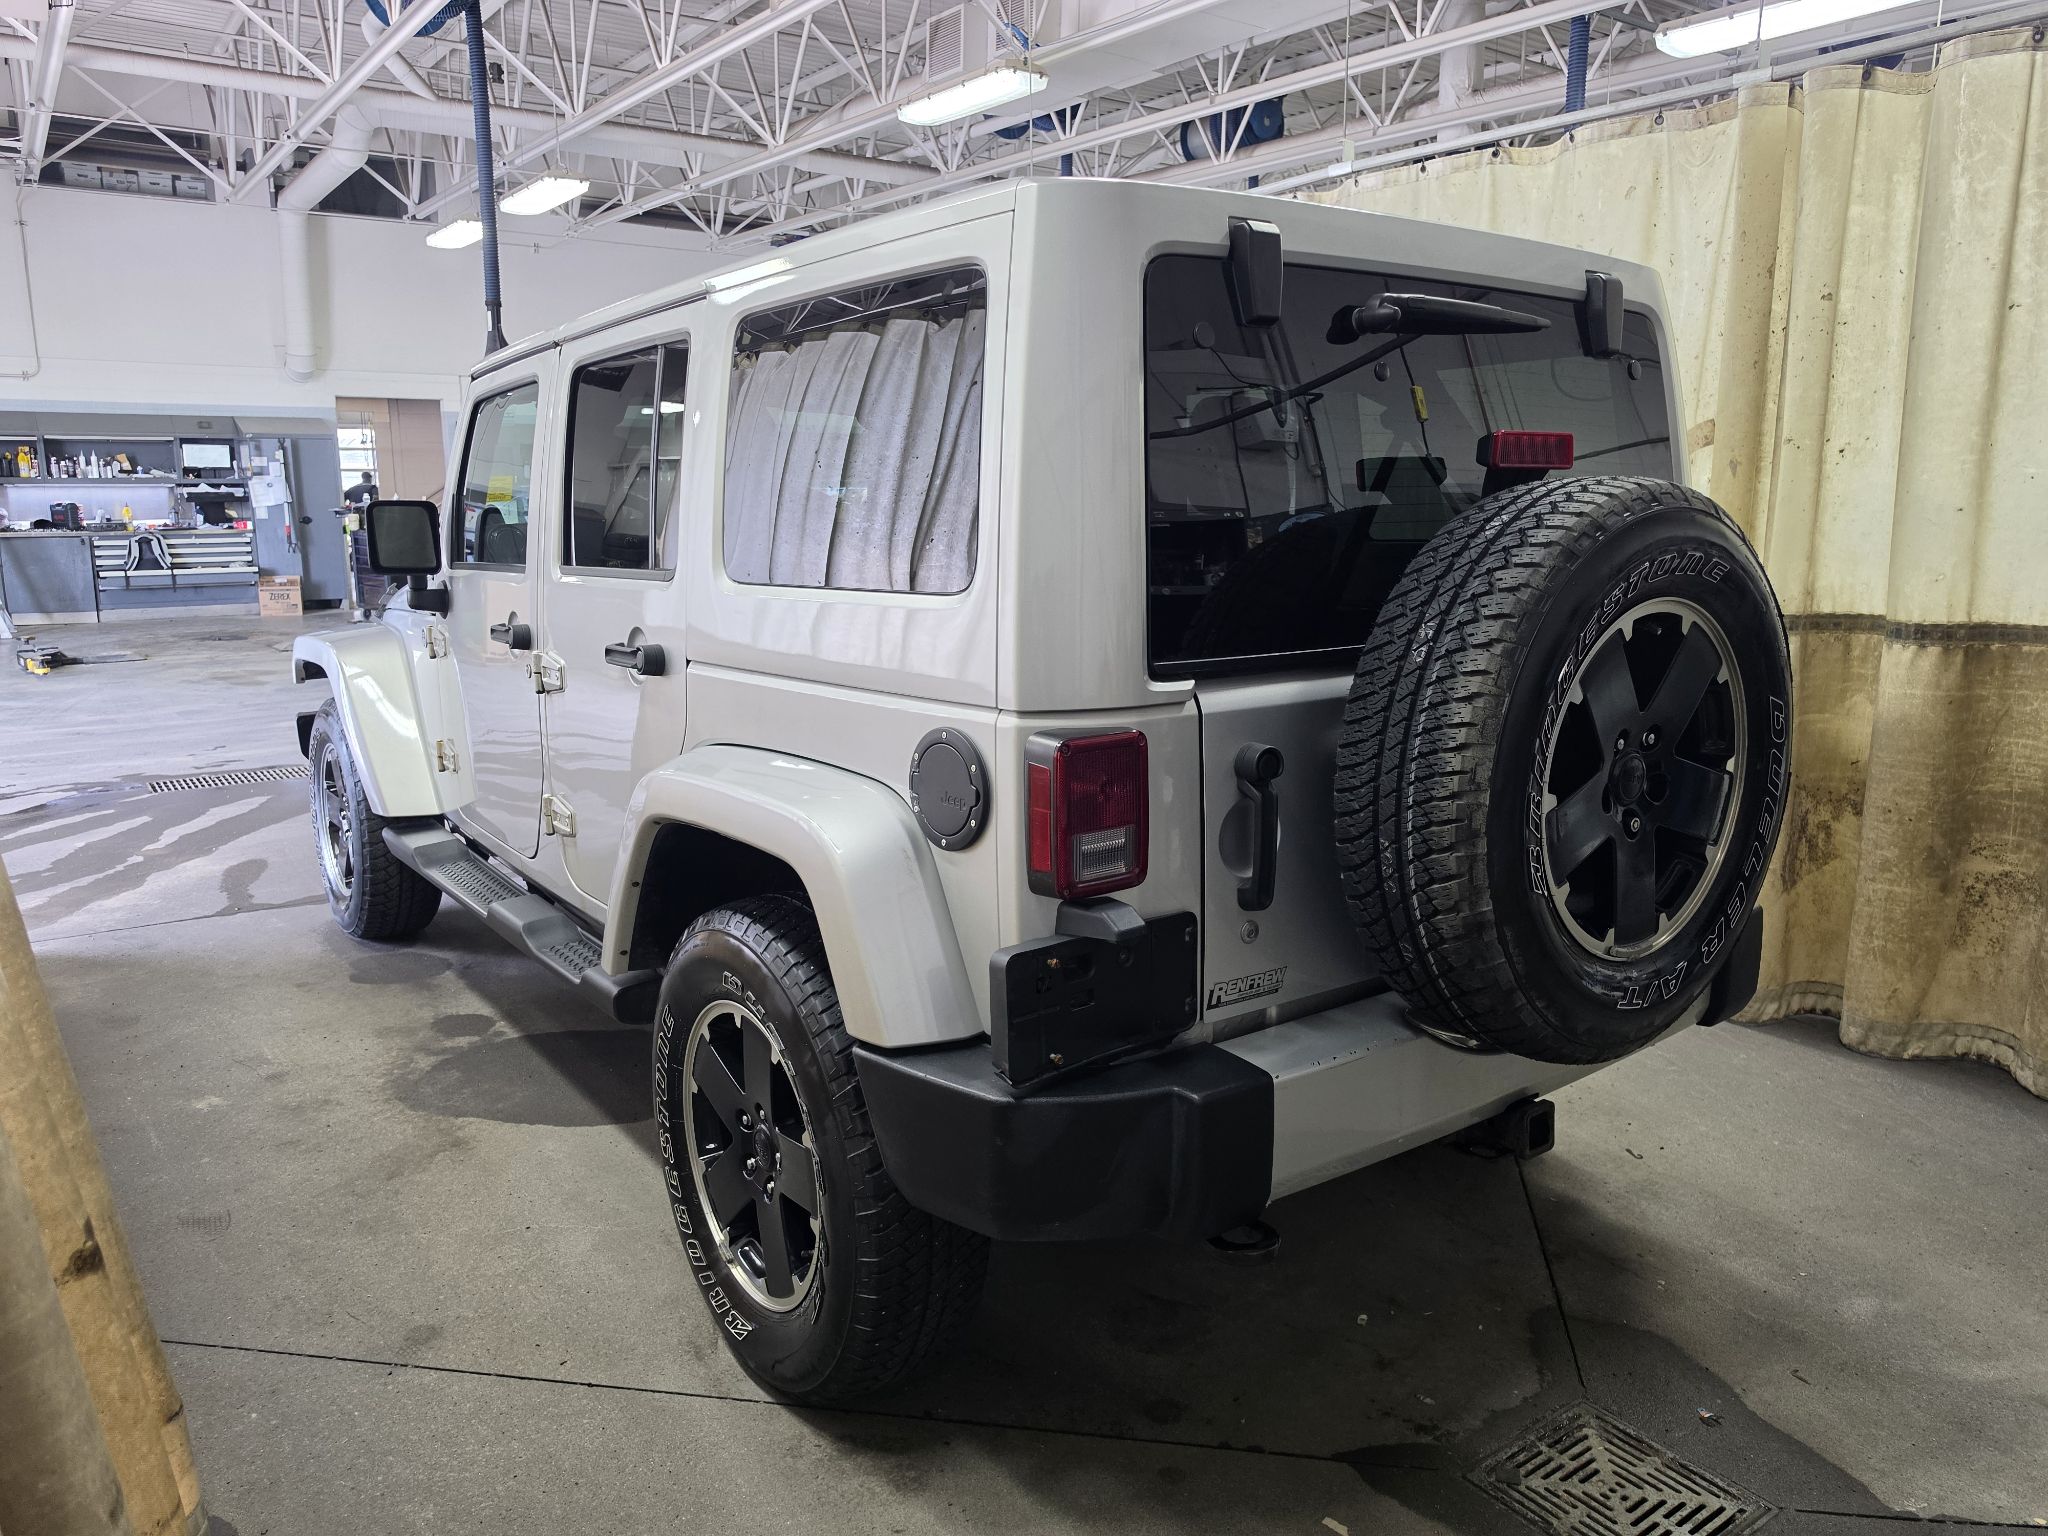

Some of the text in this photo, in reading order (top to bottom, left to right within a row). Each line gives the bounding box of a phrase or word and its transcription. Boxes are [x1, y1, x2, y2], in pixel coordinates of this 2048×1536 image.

[941, 791, 967, 813] Jeep
[1617, 695, 1787, 1010] DUELER A/T
[1208, 966, 1288, 1008] RENFREW
[655, 1004, 753, 1341] BRIDGESTONE
